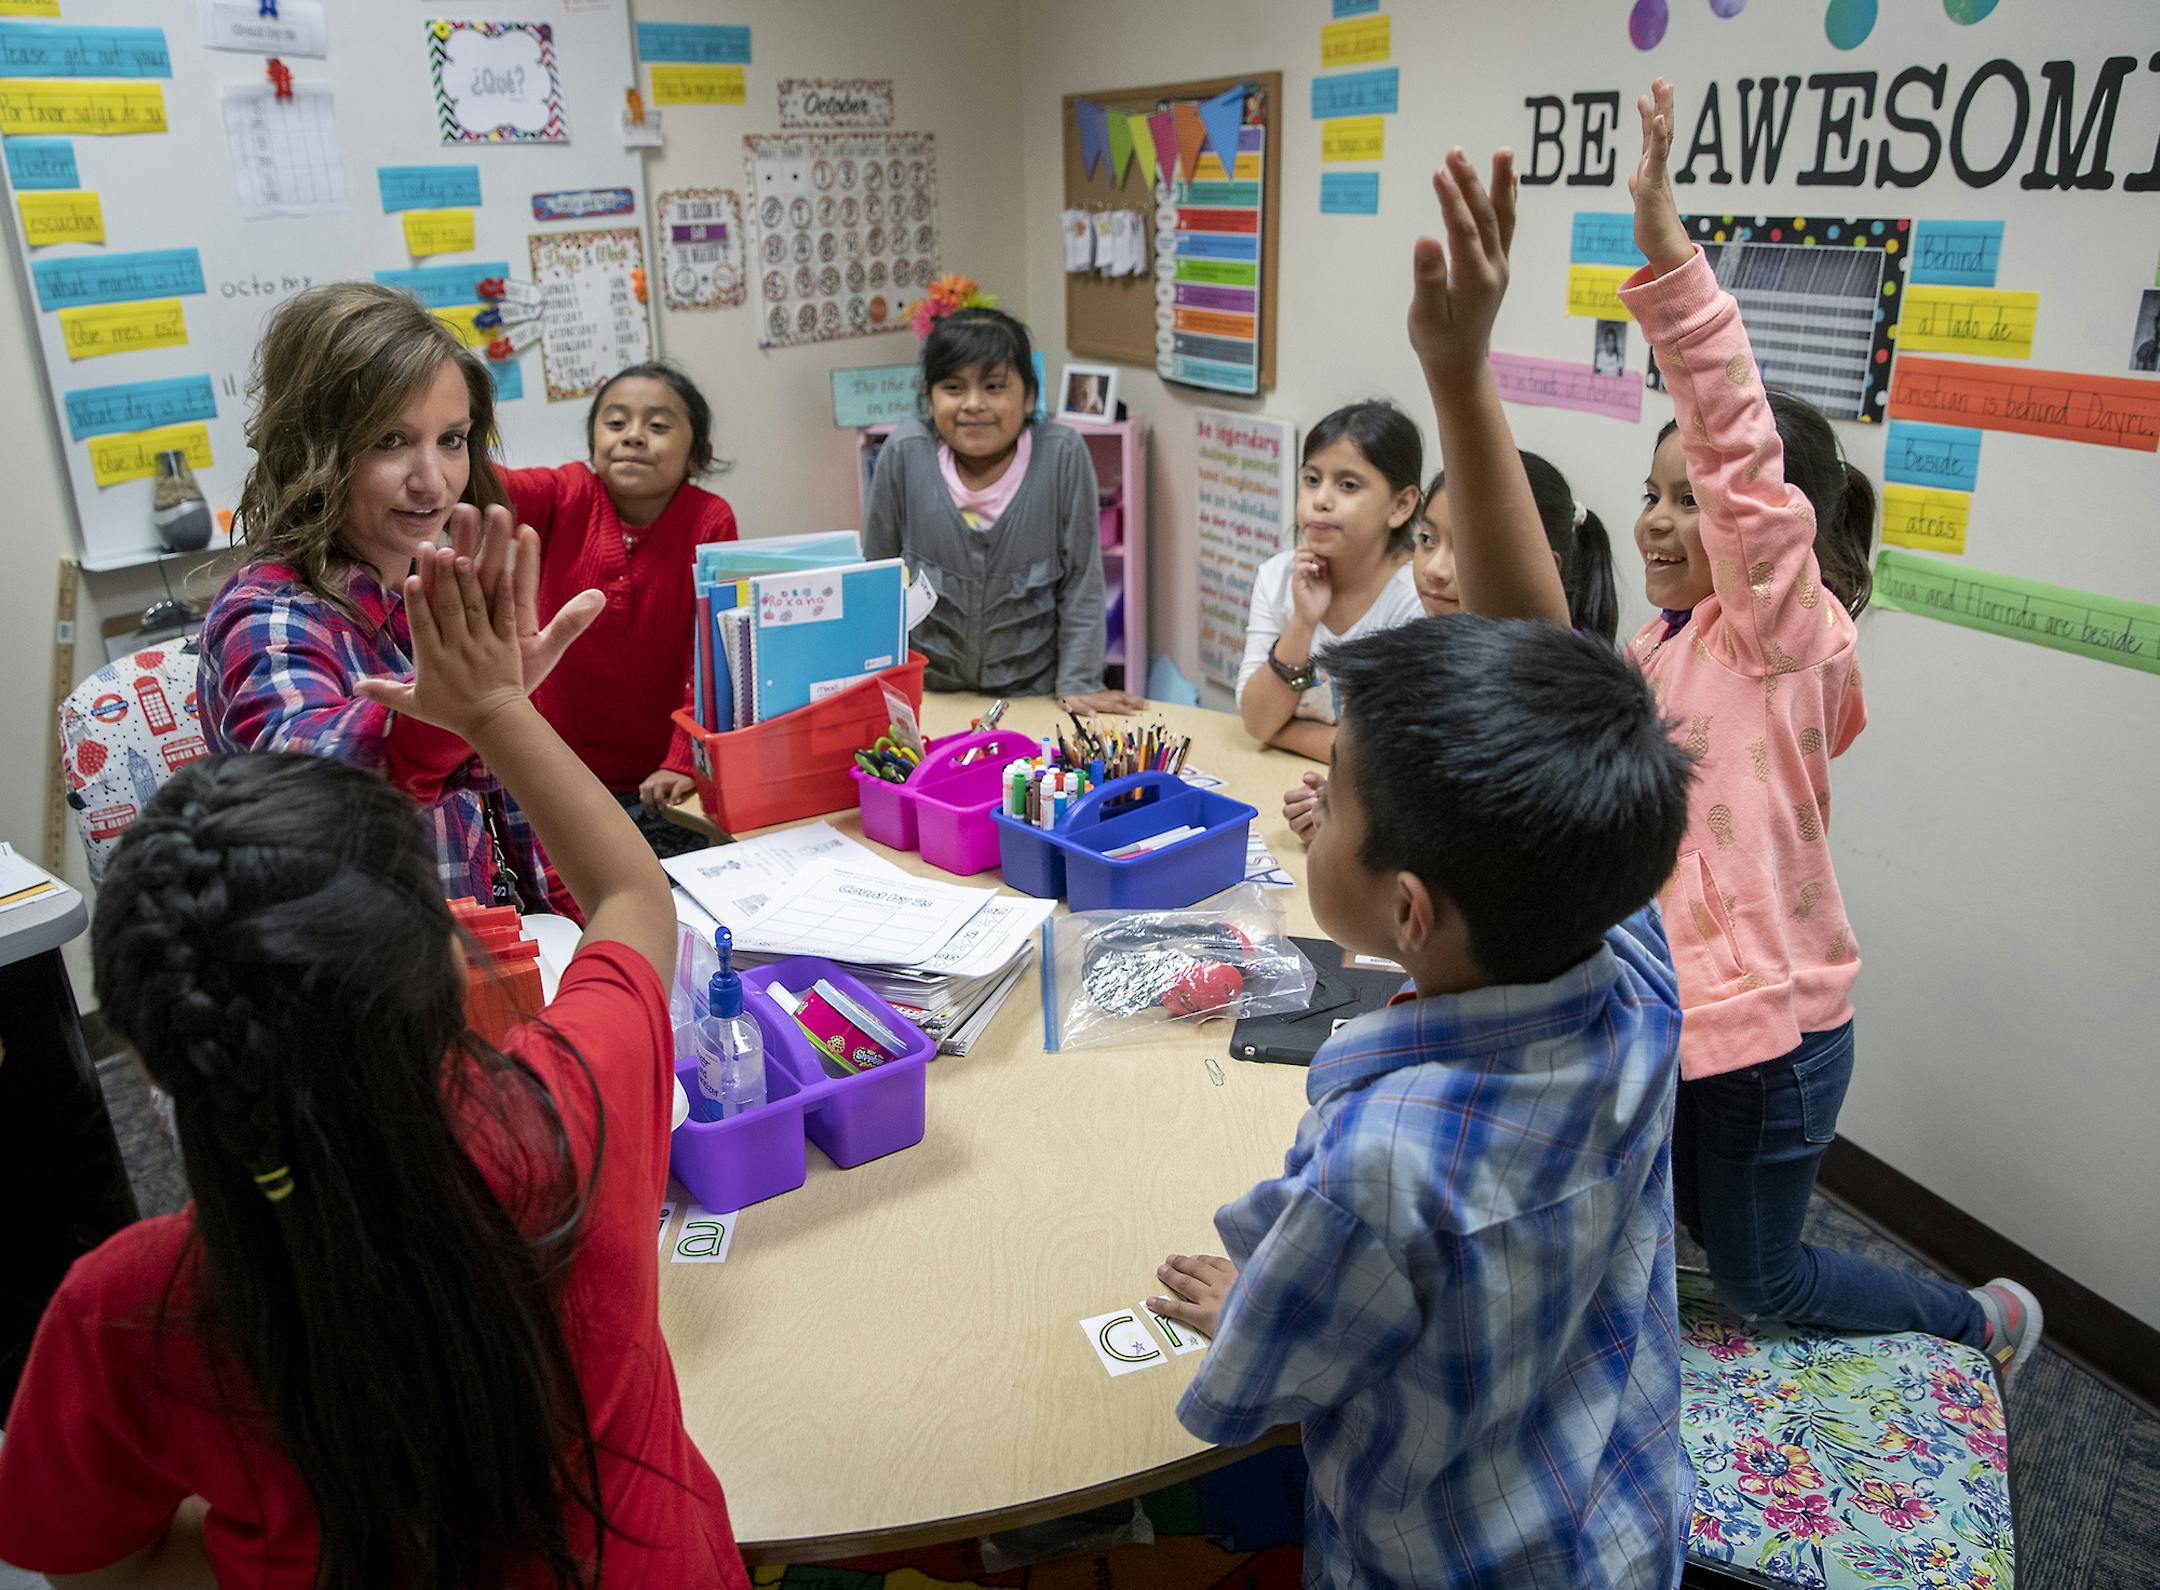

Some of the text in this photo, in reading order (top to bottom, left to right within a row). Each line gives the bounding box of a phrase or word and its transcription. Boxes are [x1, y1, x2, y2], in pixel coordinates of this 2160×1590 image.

[803, 92, 870, 117] October
[1520, 91, 1620, 186] BE
[1920, 234, 1986, 272] Behind
[1947, 303, 1980, 339] lado
[1989, 305, 2012, 342] de
[1898, 371, 1968, 412] Cristian
[1981, 396, 1998, 416] is
[2005, 382, 2072, 427] behind
[1215, 426, 1280, 458] legendary
[1903, 437, 1965, 476] Beside
[1925, 578, 1958, 610] and
[2045, 616, 2076, 638] are
[2082, 608, 2143, 655] beside
[677, 1221, 725, 1257] a
